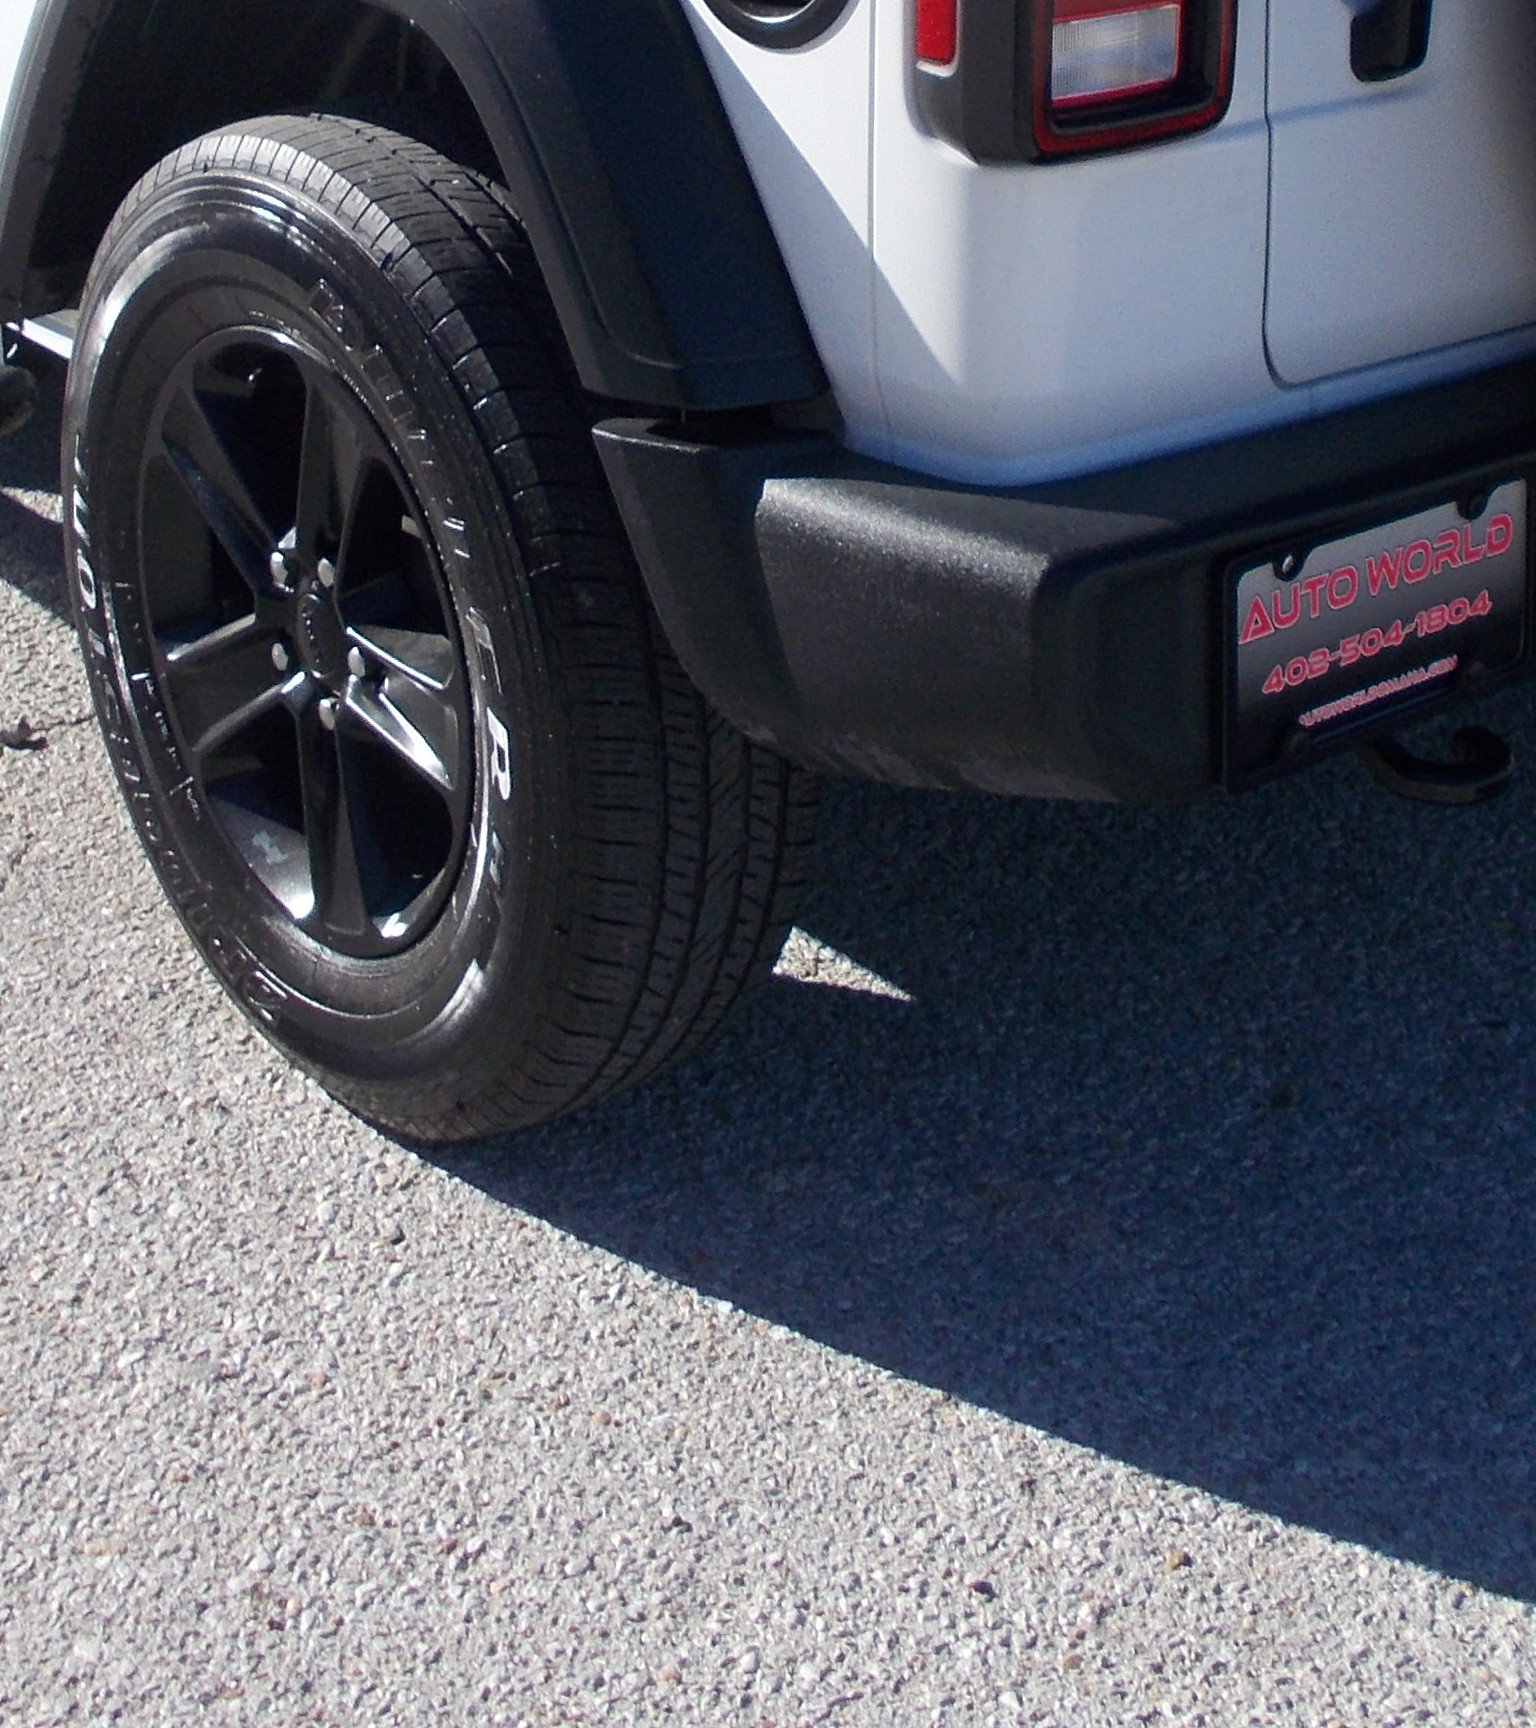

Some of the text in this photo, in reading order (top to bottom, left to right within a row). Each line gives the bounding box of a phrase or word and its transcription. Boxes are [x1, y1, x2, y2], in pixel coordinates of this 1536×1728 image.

[1239, 514, 1513, 644] AUTO WORLD
[1262, 590, 1493, 694] 402-504-1804
